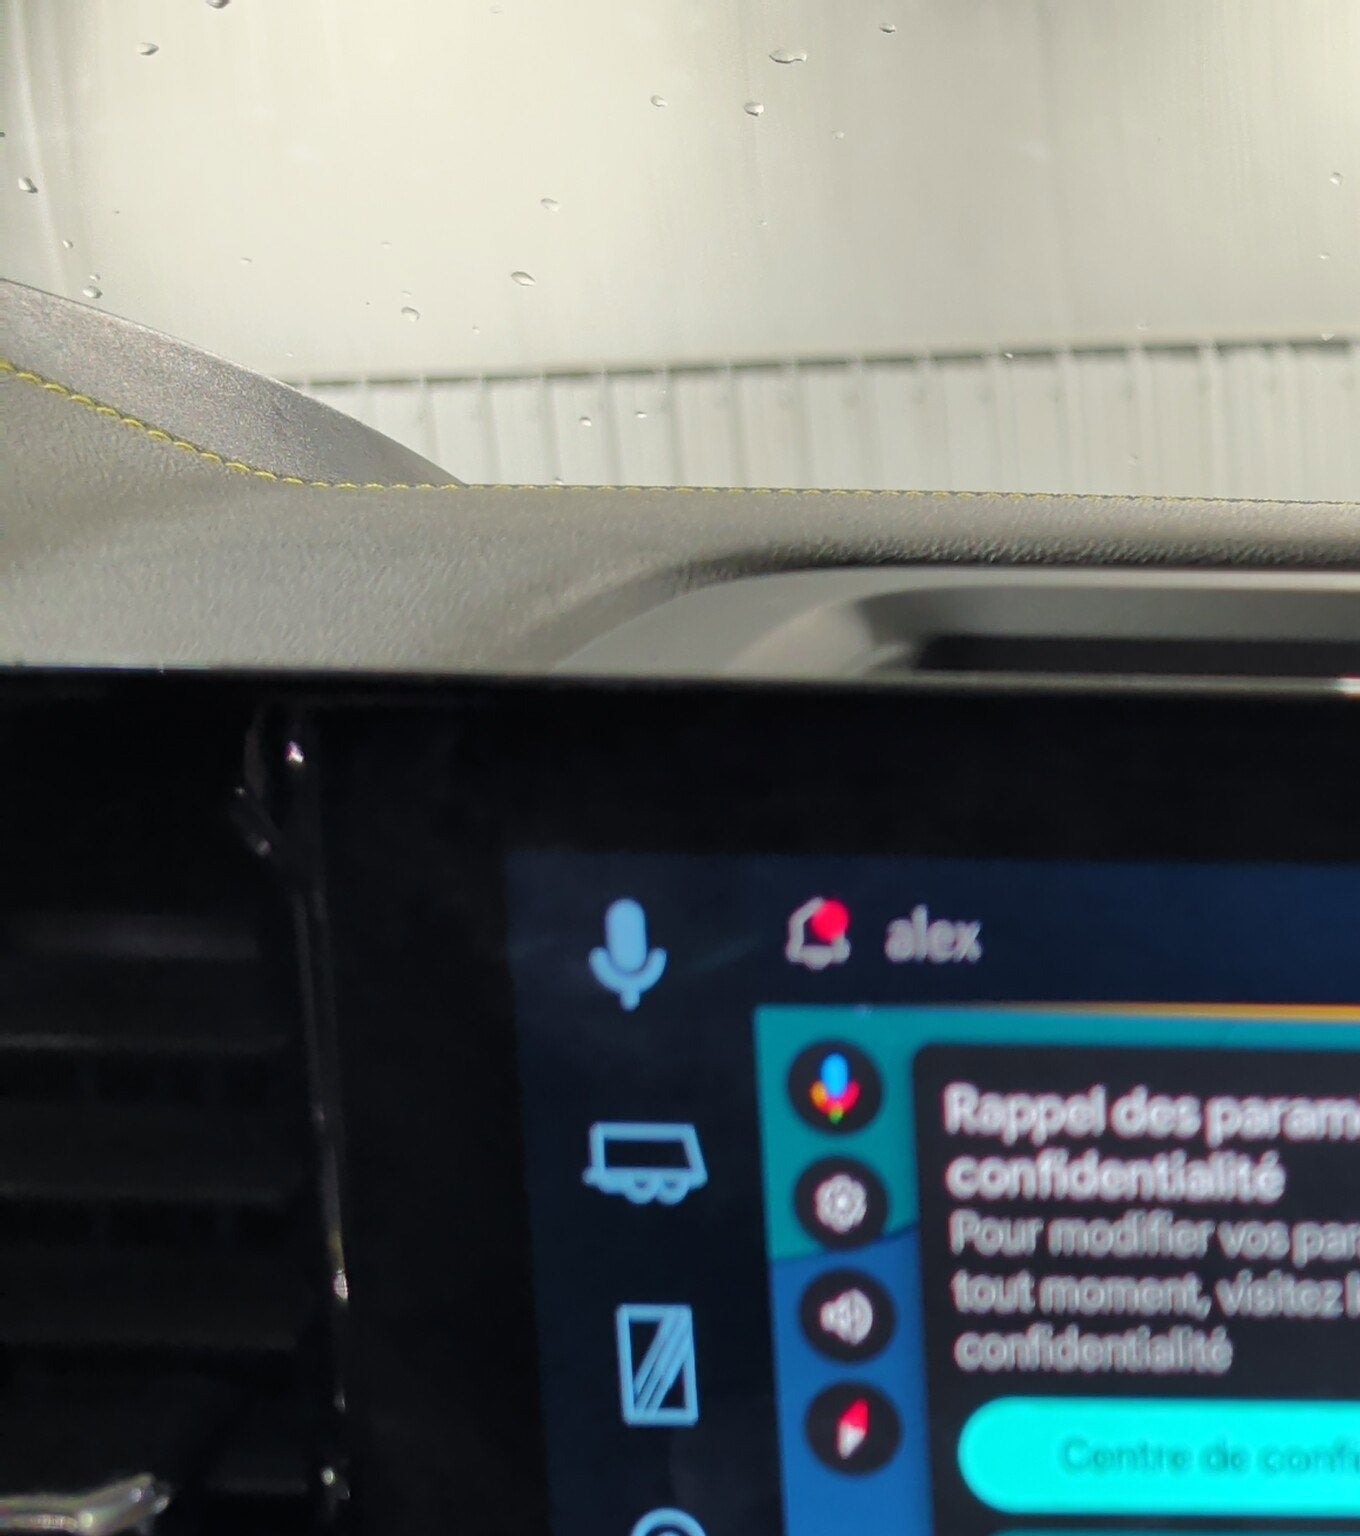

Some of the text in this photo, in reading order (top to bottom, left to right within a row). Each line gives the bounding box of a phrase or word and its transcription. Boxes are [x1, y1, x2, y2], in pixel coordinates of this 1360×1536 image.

[884, 904, 983, 963] alex
[944, 1083, 1104, 1145] Rappel
[1111, 1085, 1202, 1138] des
[945, 1147, 1287, 1201] confidentialité
[950, 1209, 1044, 1256] Pour
[1048, 1209, 1215, 1260] modifier
[1218, 1221, 1290, 1261] vos
[951, 1269, 1035, 1315] tout
[1040, 1271, 1212, 1319] moment,
[1216, 1270, 1343, 1319] visitez
[954, 1323, 1233, 1373] confidentialité
[1062, 1436, 1190, 1475] Centre
[1206, 1436, 1248, 1475] de
